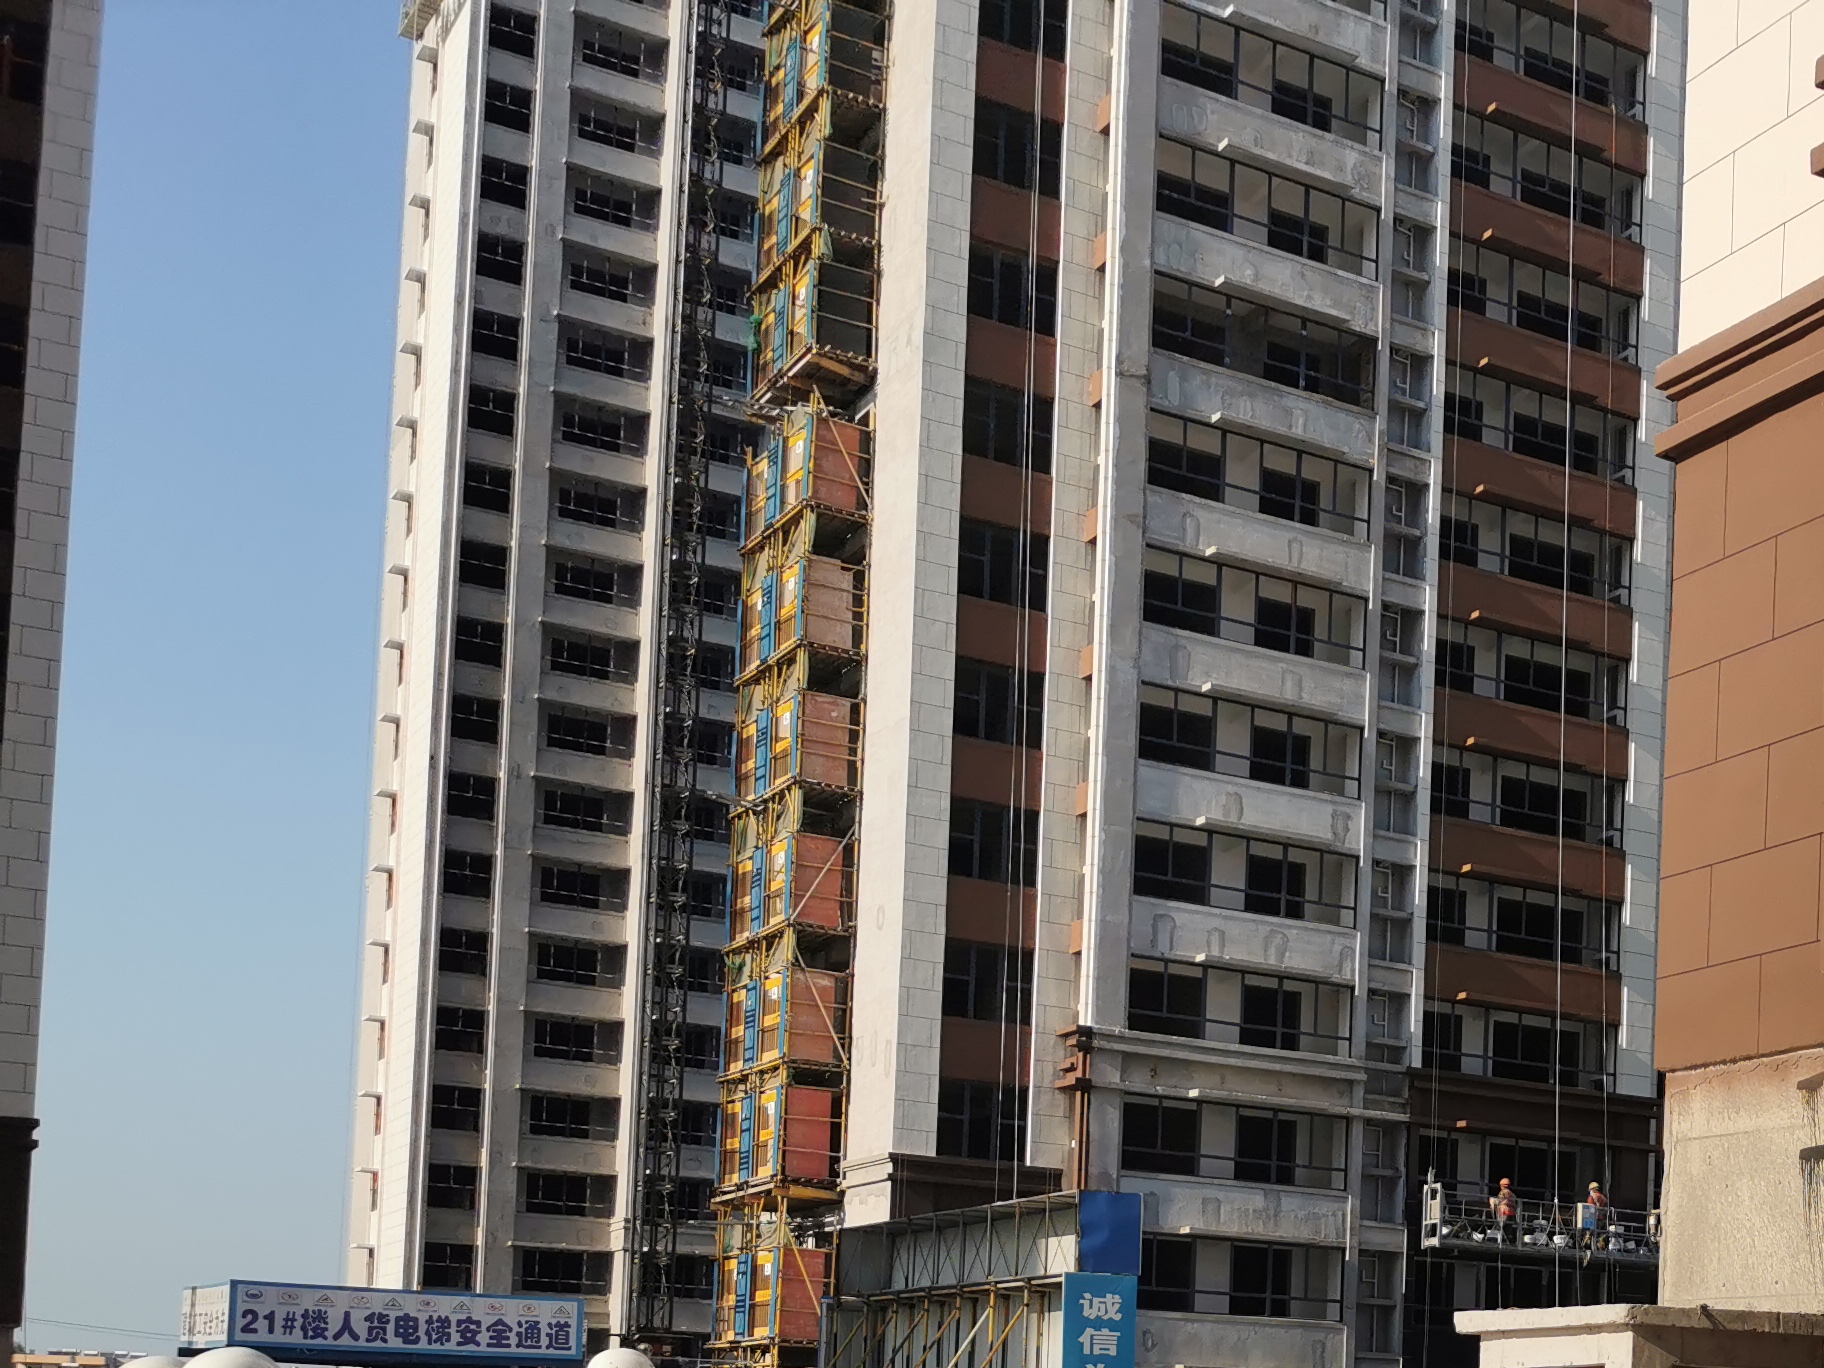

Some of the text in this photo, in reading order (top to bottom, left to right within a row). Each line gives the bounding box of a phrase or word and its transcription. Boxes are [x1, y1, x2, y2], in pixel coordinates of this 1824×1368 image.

[240, 1308, 573, 1352] 21#楼人货电梯安全通道
